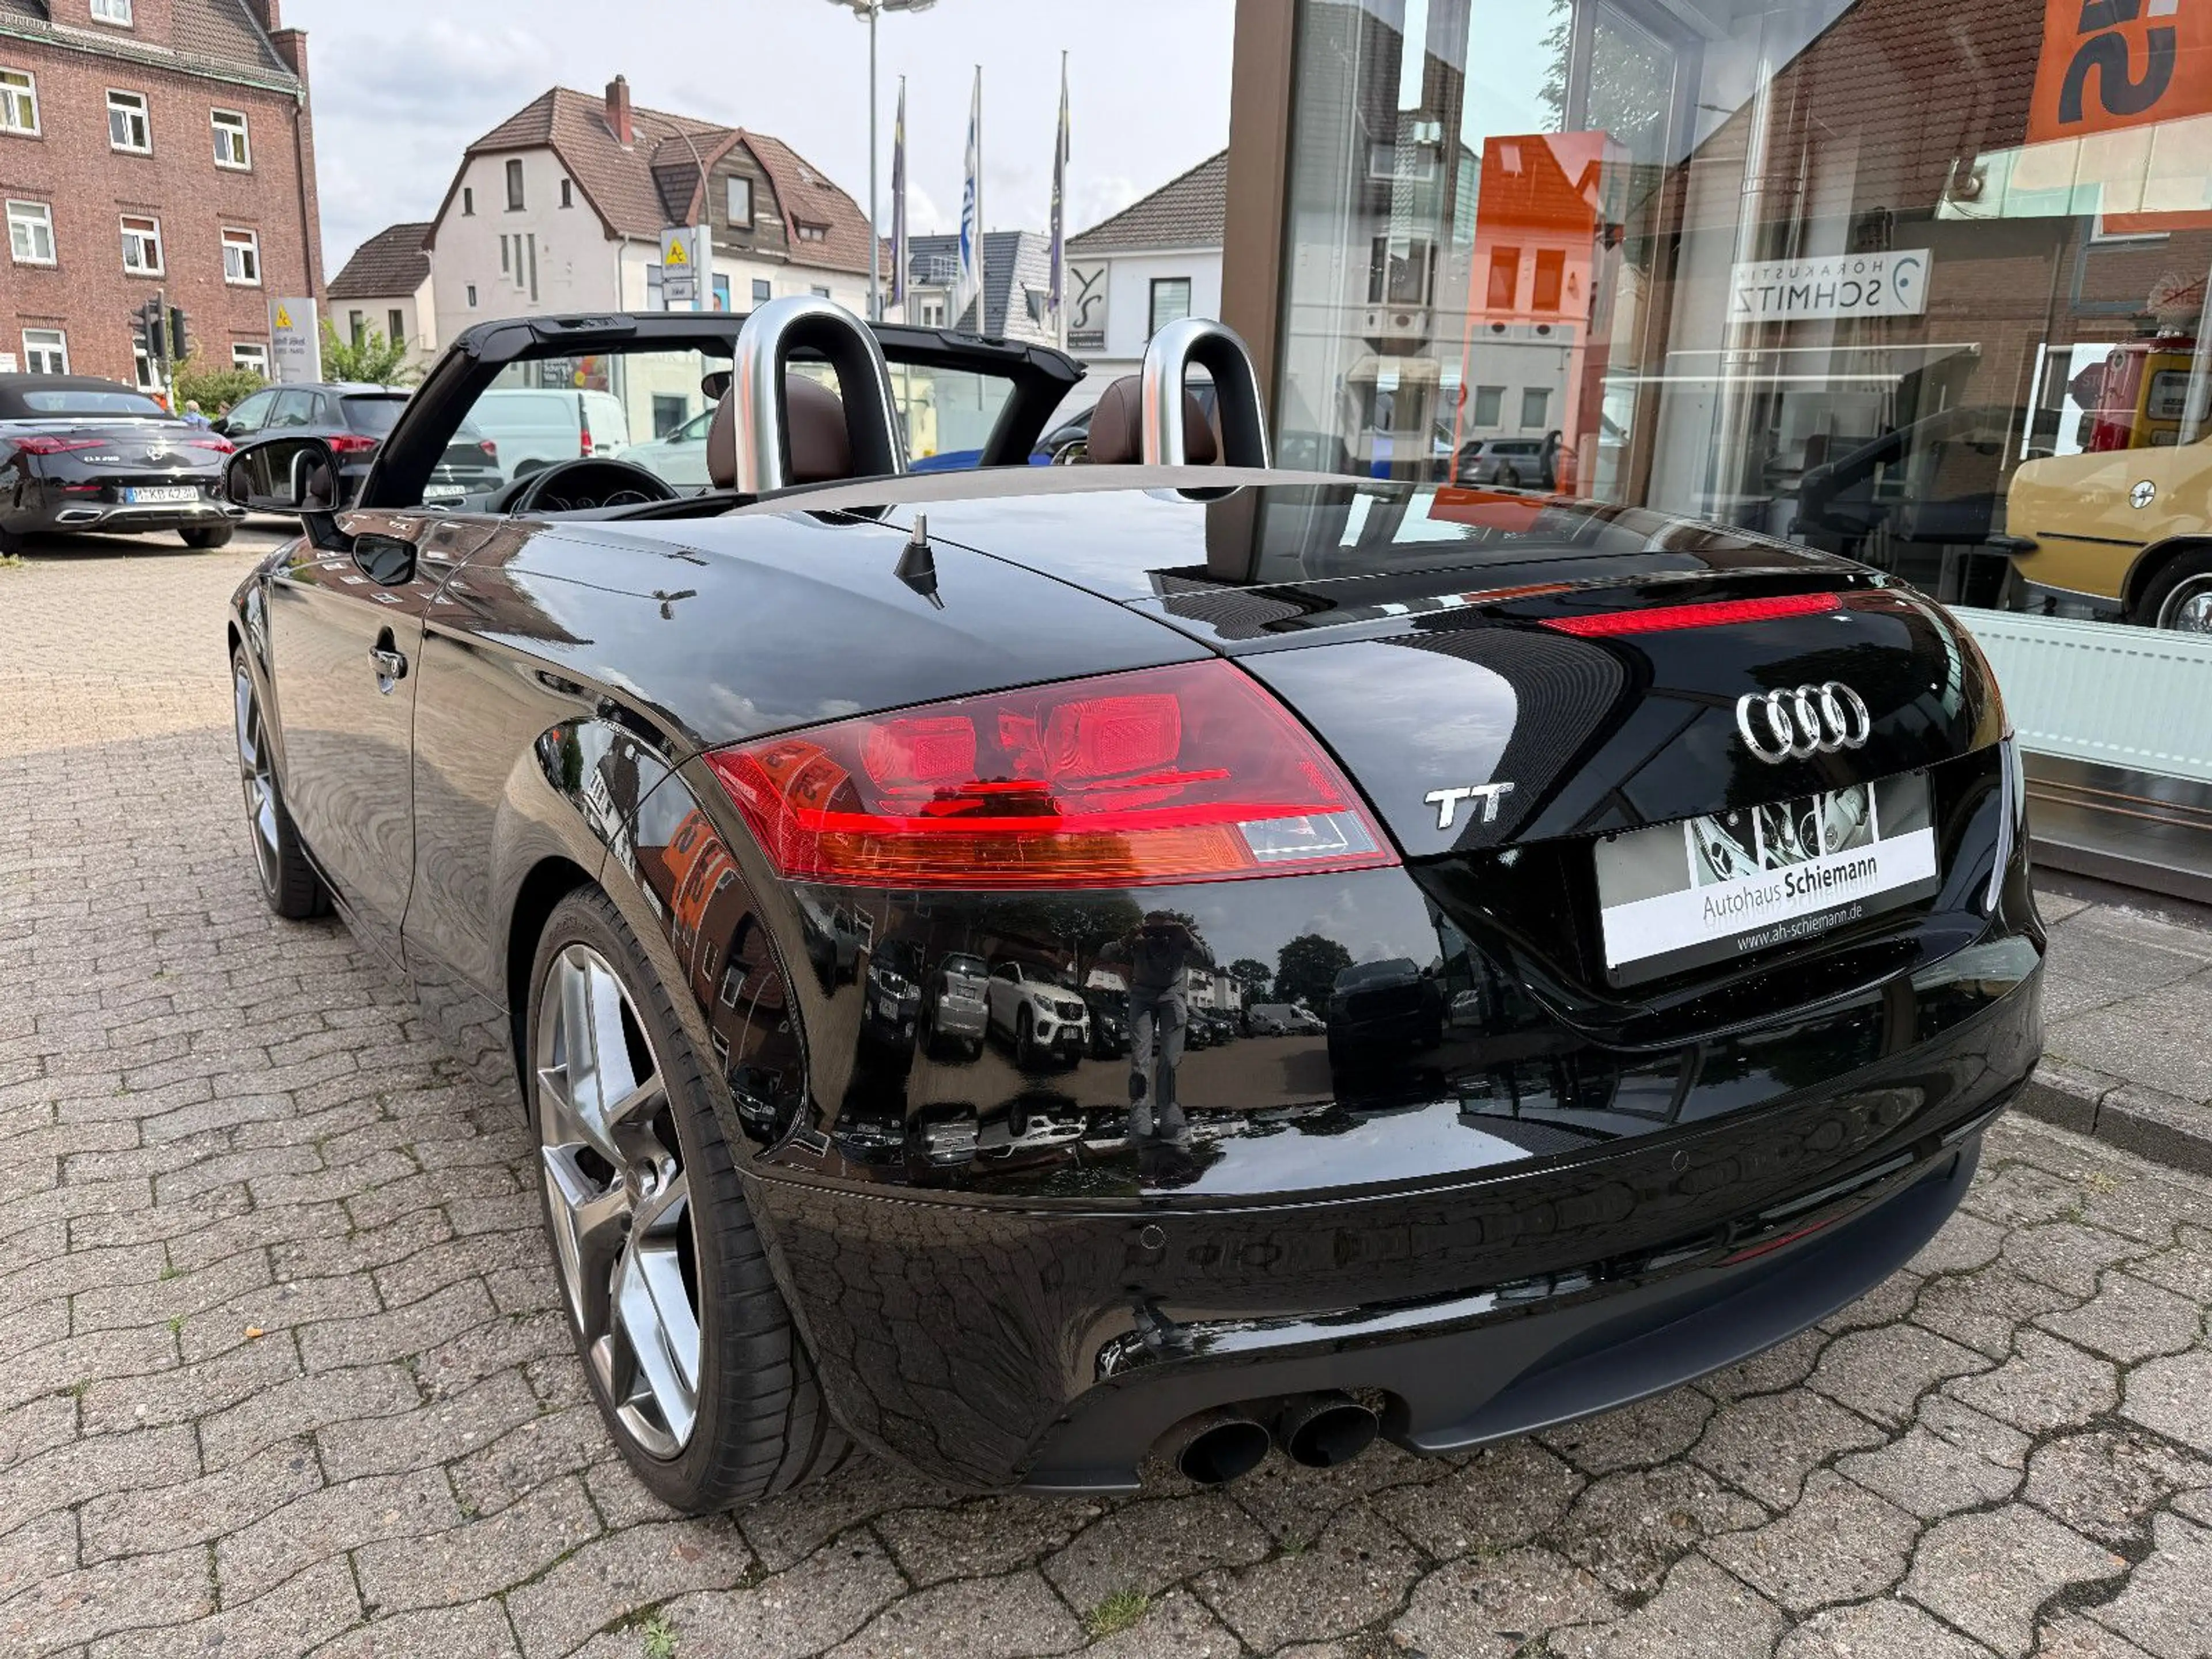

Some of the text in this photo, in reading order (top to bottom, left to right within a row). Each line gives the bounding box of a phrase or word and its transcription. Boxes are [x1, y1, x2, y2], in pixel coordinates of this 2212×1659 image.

[1425, 782, 1514, 830] TT
[1703, 856, 1877, 921] Autohaus Schiemann
[1737, 903, 1862, 951] www.ah-schiemann.de
